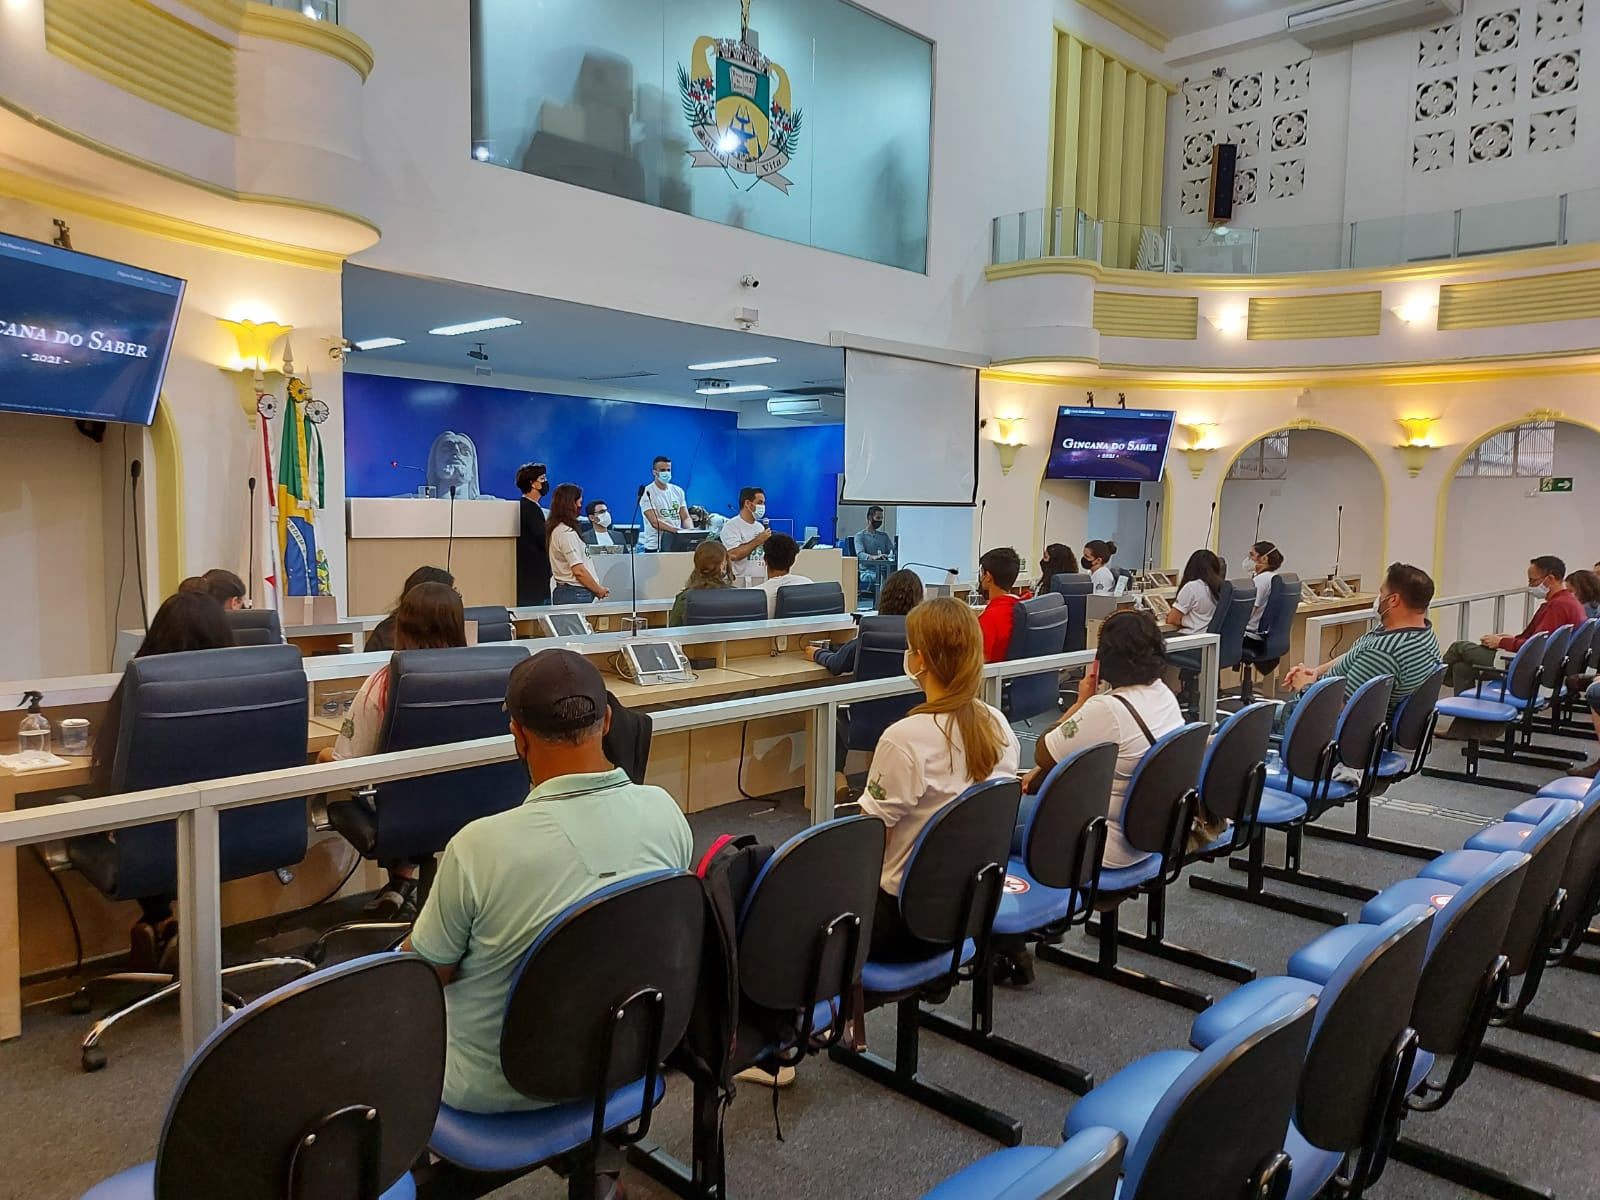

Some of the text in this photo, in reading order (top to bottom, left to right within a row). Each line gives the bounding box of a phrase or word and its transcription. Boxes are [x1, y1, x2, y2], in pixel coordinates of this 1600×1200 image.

[762, 159, 782, 172] Vita
[53, 330, 83, 347] DO
[88, 330, 148, 358] SABER
[31, 353, 61, 365] 2021
[1062, 438, 1157, 452] GINCANA DO SABER
